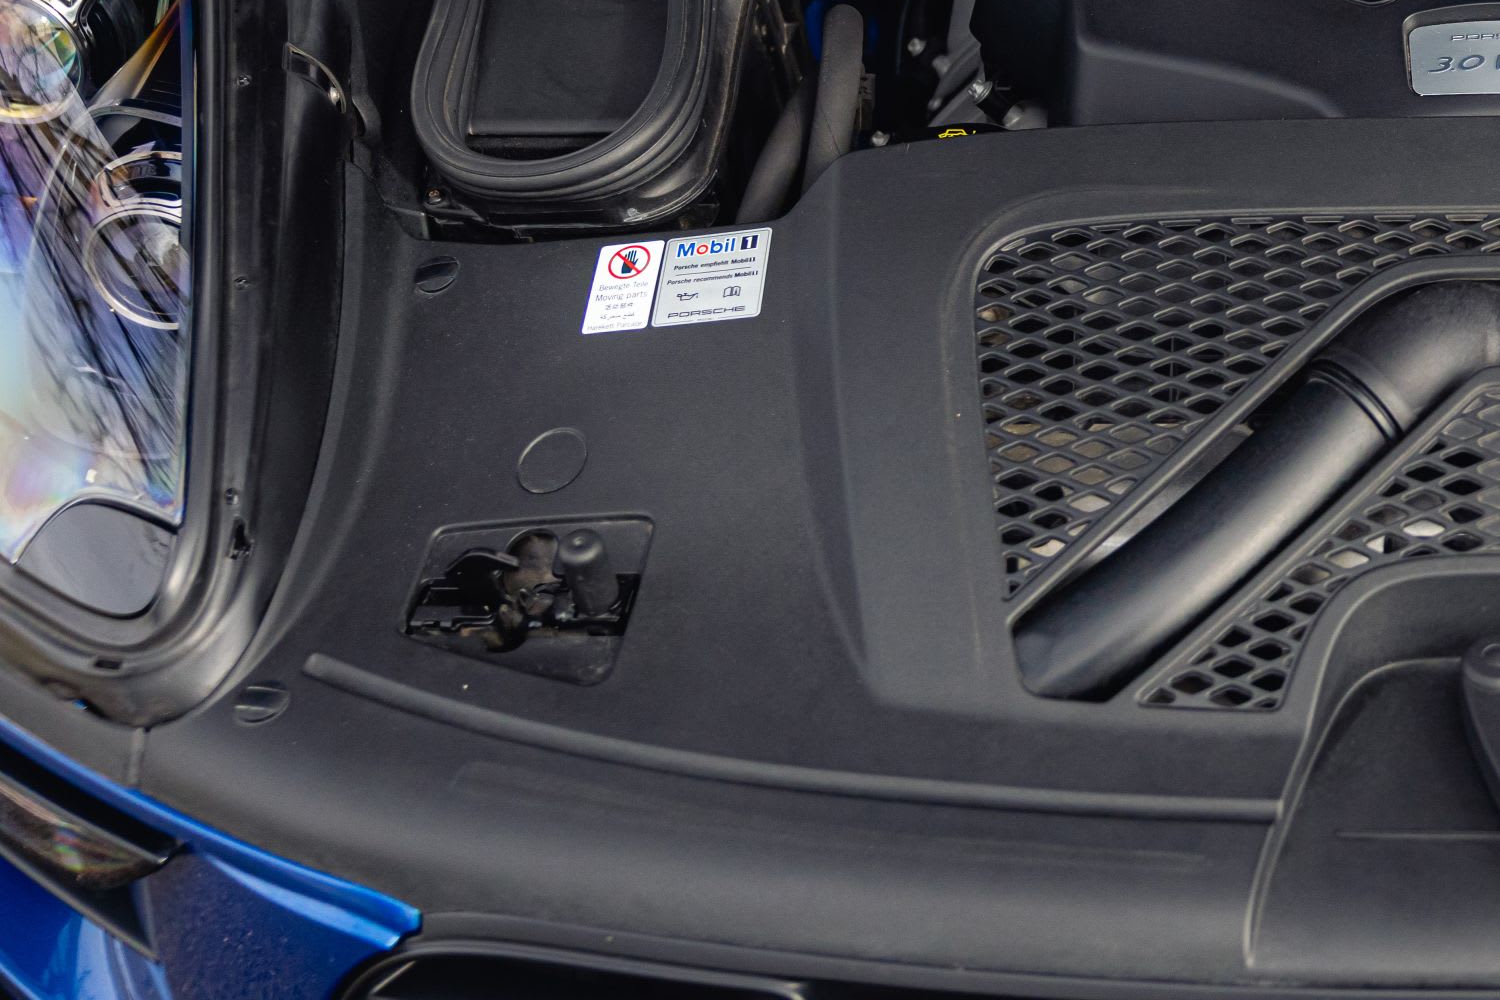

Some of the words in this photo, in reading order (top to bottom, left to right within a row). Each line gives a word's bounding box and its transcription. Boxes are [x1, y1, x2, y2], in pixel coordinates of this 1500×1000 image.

[677, 238, 737, 258] Mobil
[673, 263, 698, 271] Porsche
[666, 278, 691, 286] Porsche
[693, 274, 733, 283] recommends
[595, 293, 624, 302] Moving
[626, 291, 648, 300] parts
[667, 305, 746, 319] PORSCHE
